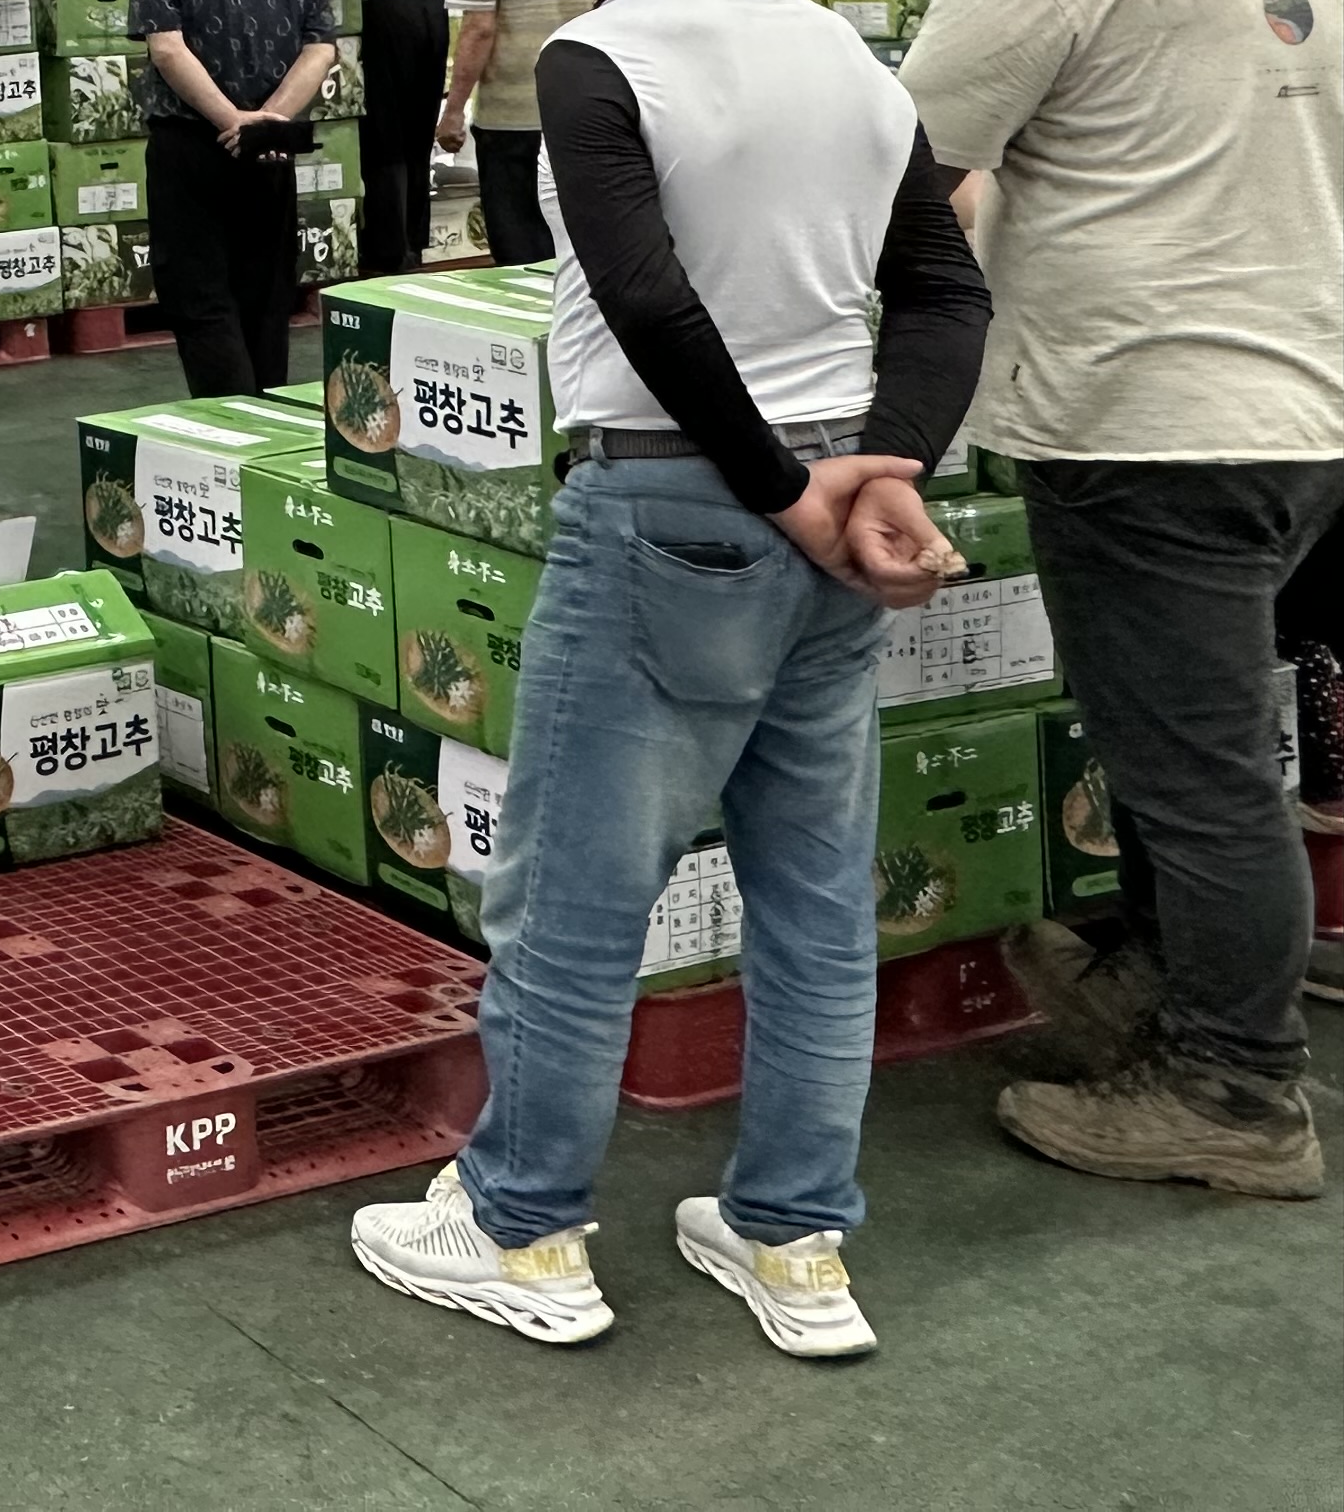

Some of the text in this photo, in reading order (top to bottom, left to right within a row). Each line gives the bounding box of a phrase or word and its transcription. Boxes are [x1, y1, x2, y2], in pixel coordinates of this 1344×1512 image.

[413, 378, 528, 449] 평창고추
[153, 494, 243, 555] 평창고추
[29, 713, 153, 776] 평창고추
[166, 1112, 237, 1156] KPP
